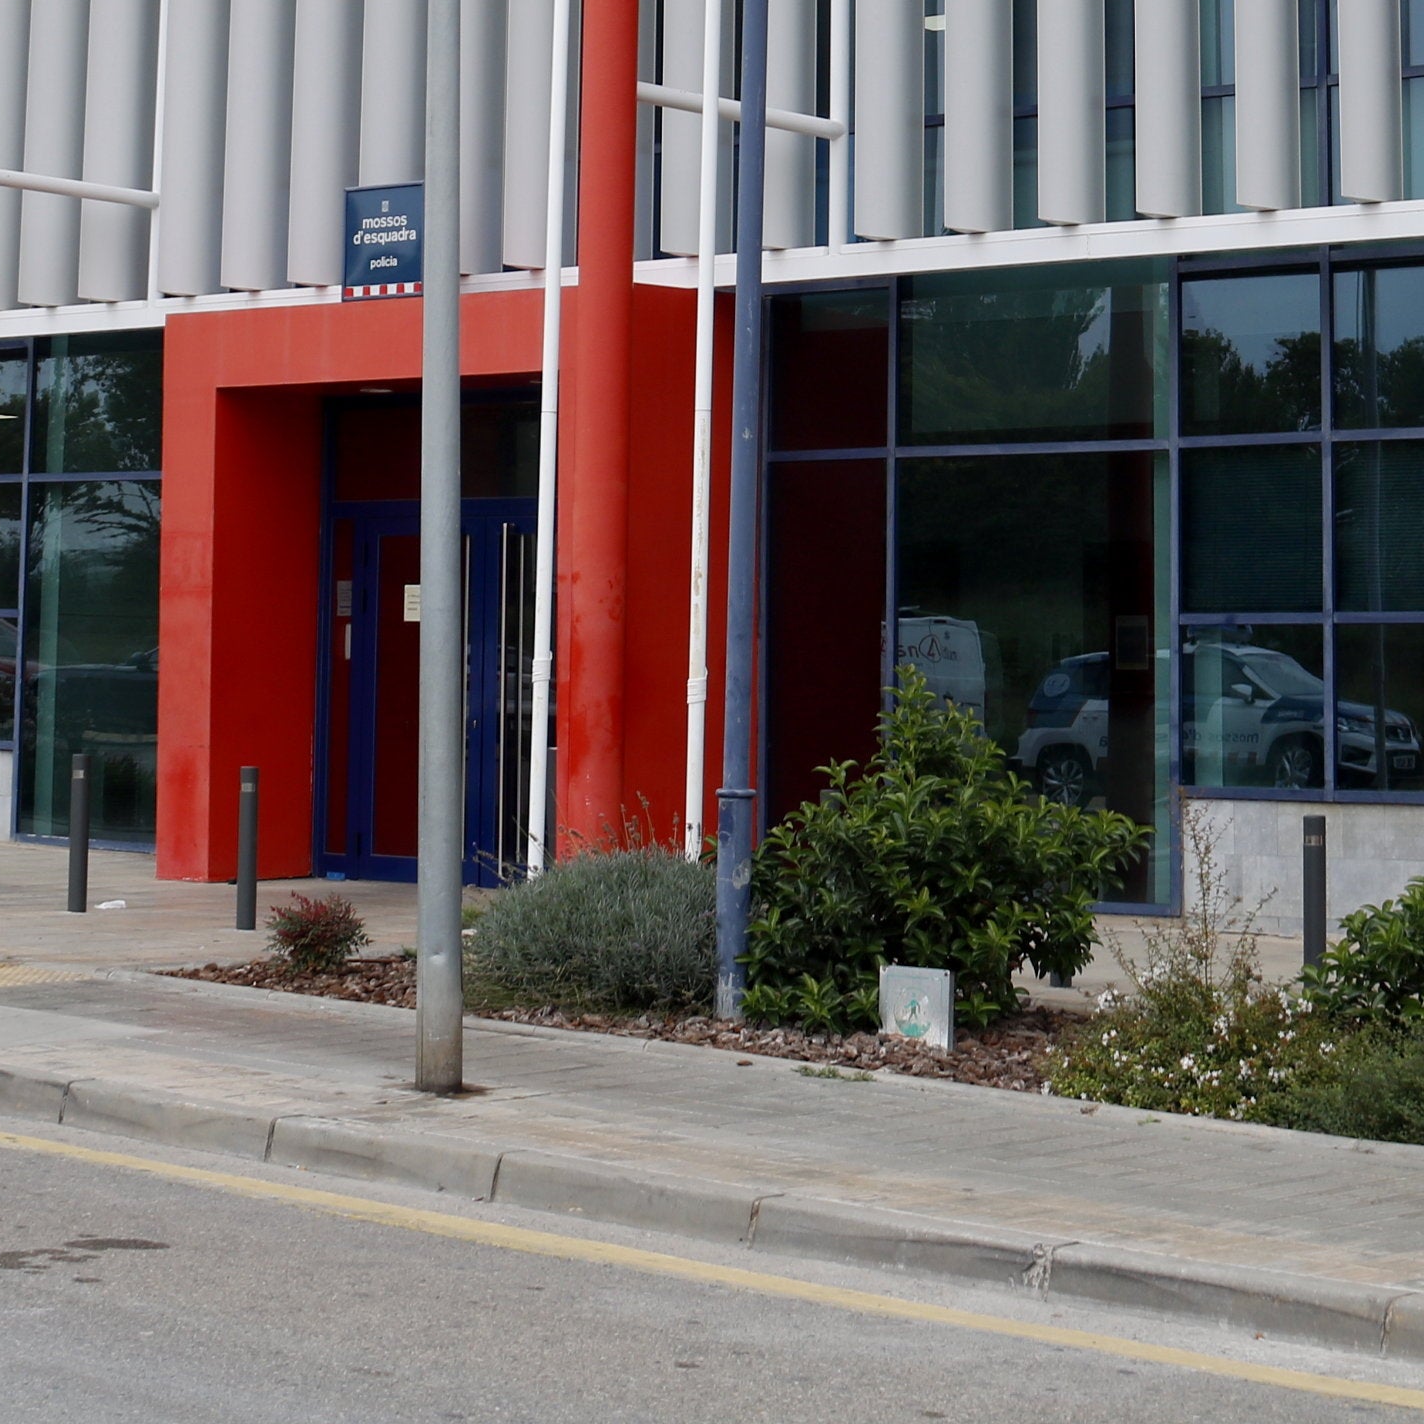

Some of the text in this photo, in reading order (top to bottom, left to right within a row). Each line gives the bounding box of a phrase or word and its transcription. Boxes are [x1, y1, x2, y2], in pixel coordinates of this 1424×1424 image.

[362, 215, 408, 229] mossos
[353, 227, 417, 245] d'esquadra
[370, 255, 398, 270] policia
